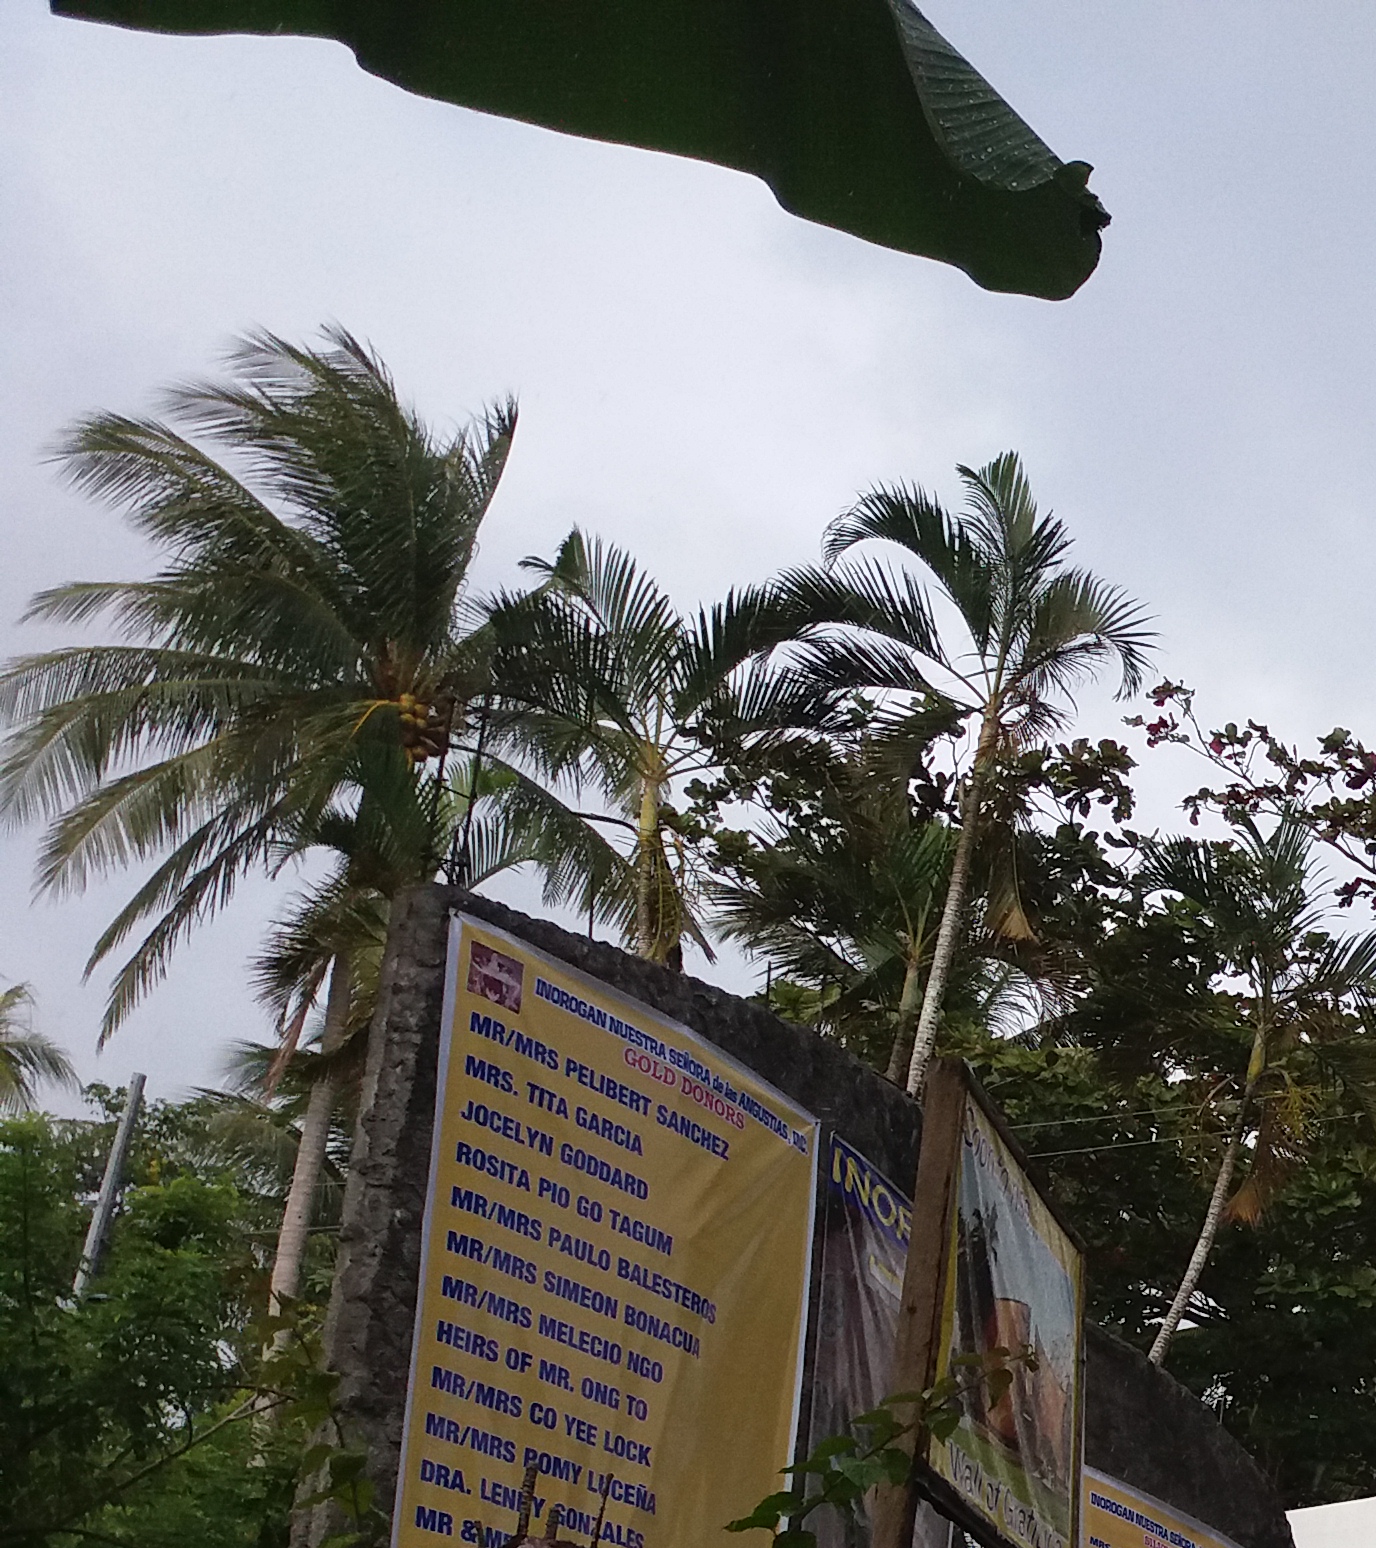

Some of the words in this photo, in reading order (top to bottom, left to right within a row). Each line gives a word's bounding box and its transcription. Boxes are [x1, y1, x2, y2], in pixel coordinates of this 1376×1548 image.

[470, 1012, 560, 1071] MR/MRS
[565, 1059, 652, 1117] PELIBERT
[656, 1104, 730, 1160] SANCHEZ
[535, 978, 608, 1031] INOROGAN
[609, 1018, 667, 1063] NUESTRA
[669, 1048, 711, 1085] SEÑORA
[713, 1075, 724, 1090] de
[724, 1081, 738, 1100] las
[624, 1048, 676, 1087] GOLD
[682, 1077, 746, 1130] DONORS
[461, 1100, 554, 1157] JOCELYN
[560, 1142, 649, 1200] GODDARD
[465, 1055, 519, 1097] MRS.
[526, 1081, 569, 1120] TITA
[575, 1106, 644, 1157] GARCIA
[456, 1142, 530, 1193] ROSITA
[539, 1177, 571, 1209] PIO
[577, 1196, 602, 1224] GO
[609, 1209, 673, 1256] TAGUM
[447, 1231, 537, 1285] MR/MRS
[543, 1271, 618, 1319] SIMEON
[624, 1305, 701, 1359] BONACUA
[450, 1186, 542, 1242] MR/MRS
[548, 1228, 611, 1272] PAULO
[617, 1258, 716, 1325] BALESTEROS
[437, 1320, 499, 1362] HEIRS
[505, 1348, 533, 1373] OF
[538, 1360, 574, 1392] MR.
[581, 1377, 620, 1410] ONG
[626, 1394, 648, 1421] TO
[441, 1276, 532, 1329] MR/MRS
[538, 1314, 622, 1365] MELECIO
[627, 1350, 663, 1383] NGO
[425, 1412, 516, 1464] MR/MRS
[587, 1470, 657, 1516] LUCEÑA
[431, 1366, 523, 1418] MR/MRS
[529, 1402, 557, 1430] CO
[564, 1414, 597, 1447] YEE
[604, 1430, 652, 1468] LOCK
[415, 1505, 453, 1536] MR
[461, 1520, 478, 1543] &
[420, 1459, 472, 1495] DRA.
